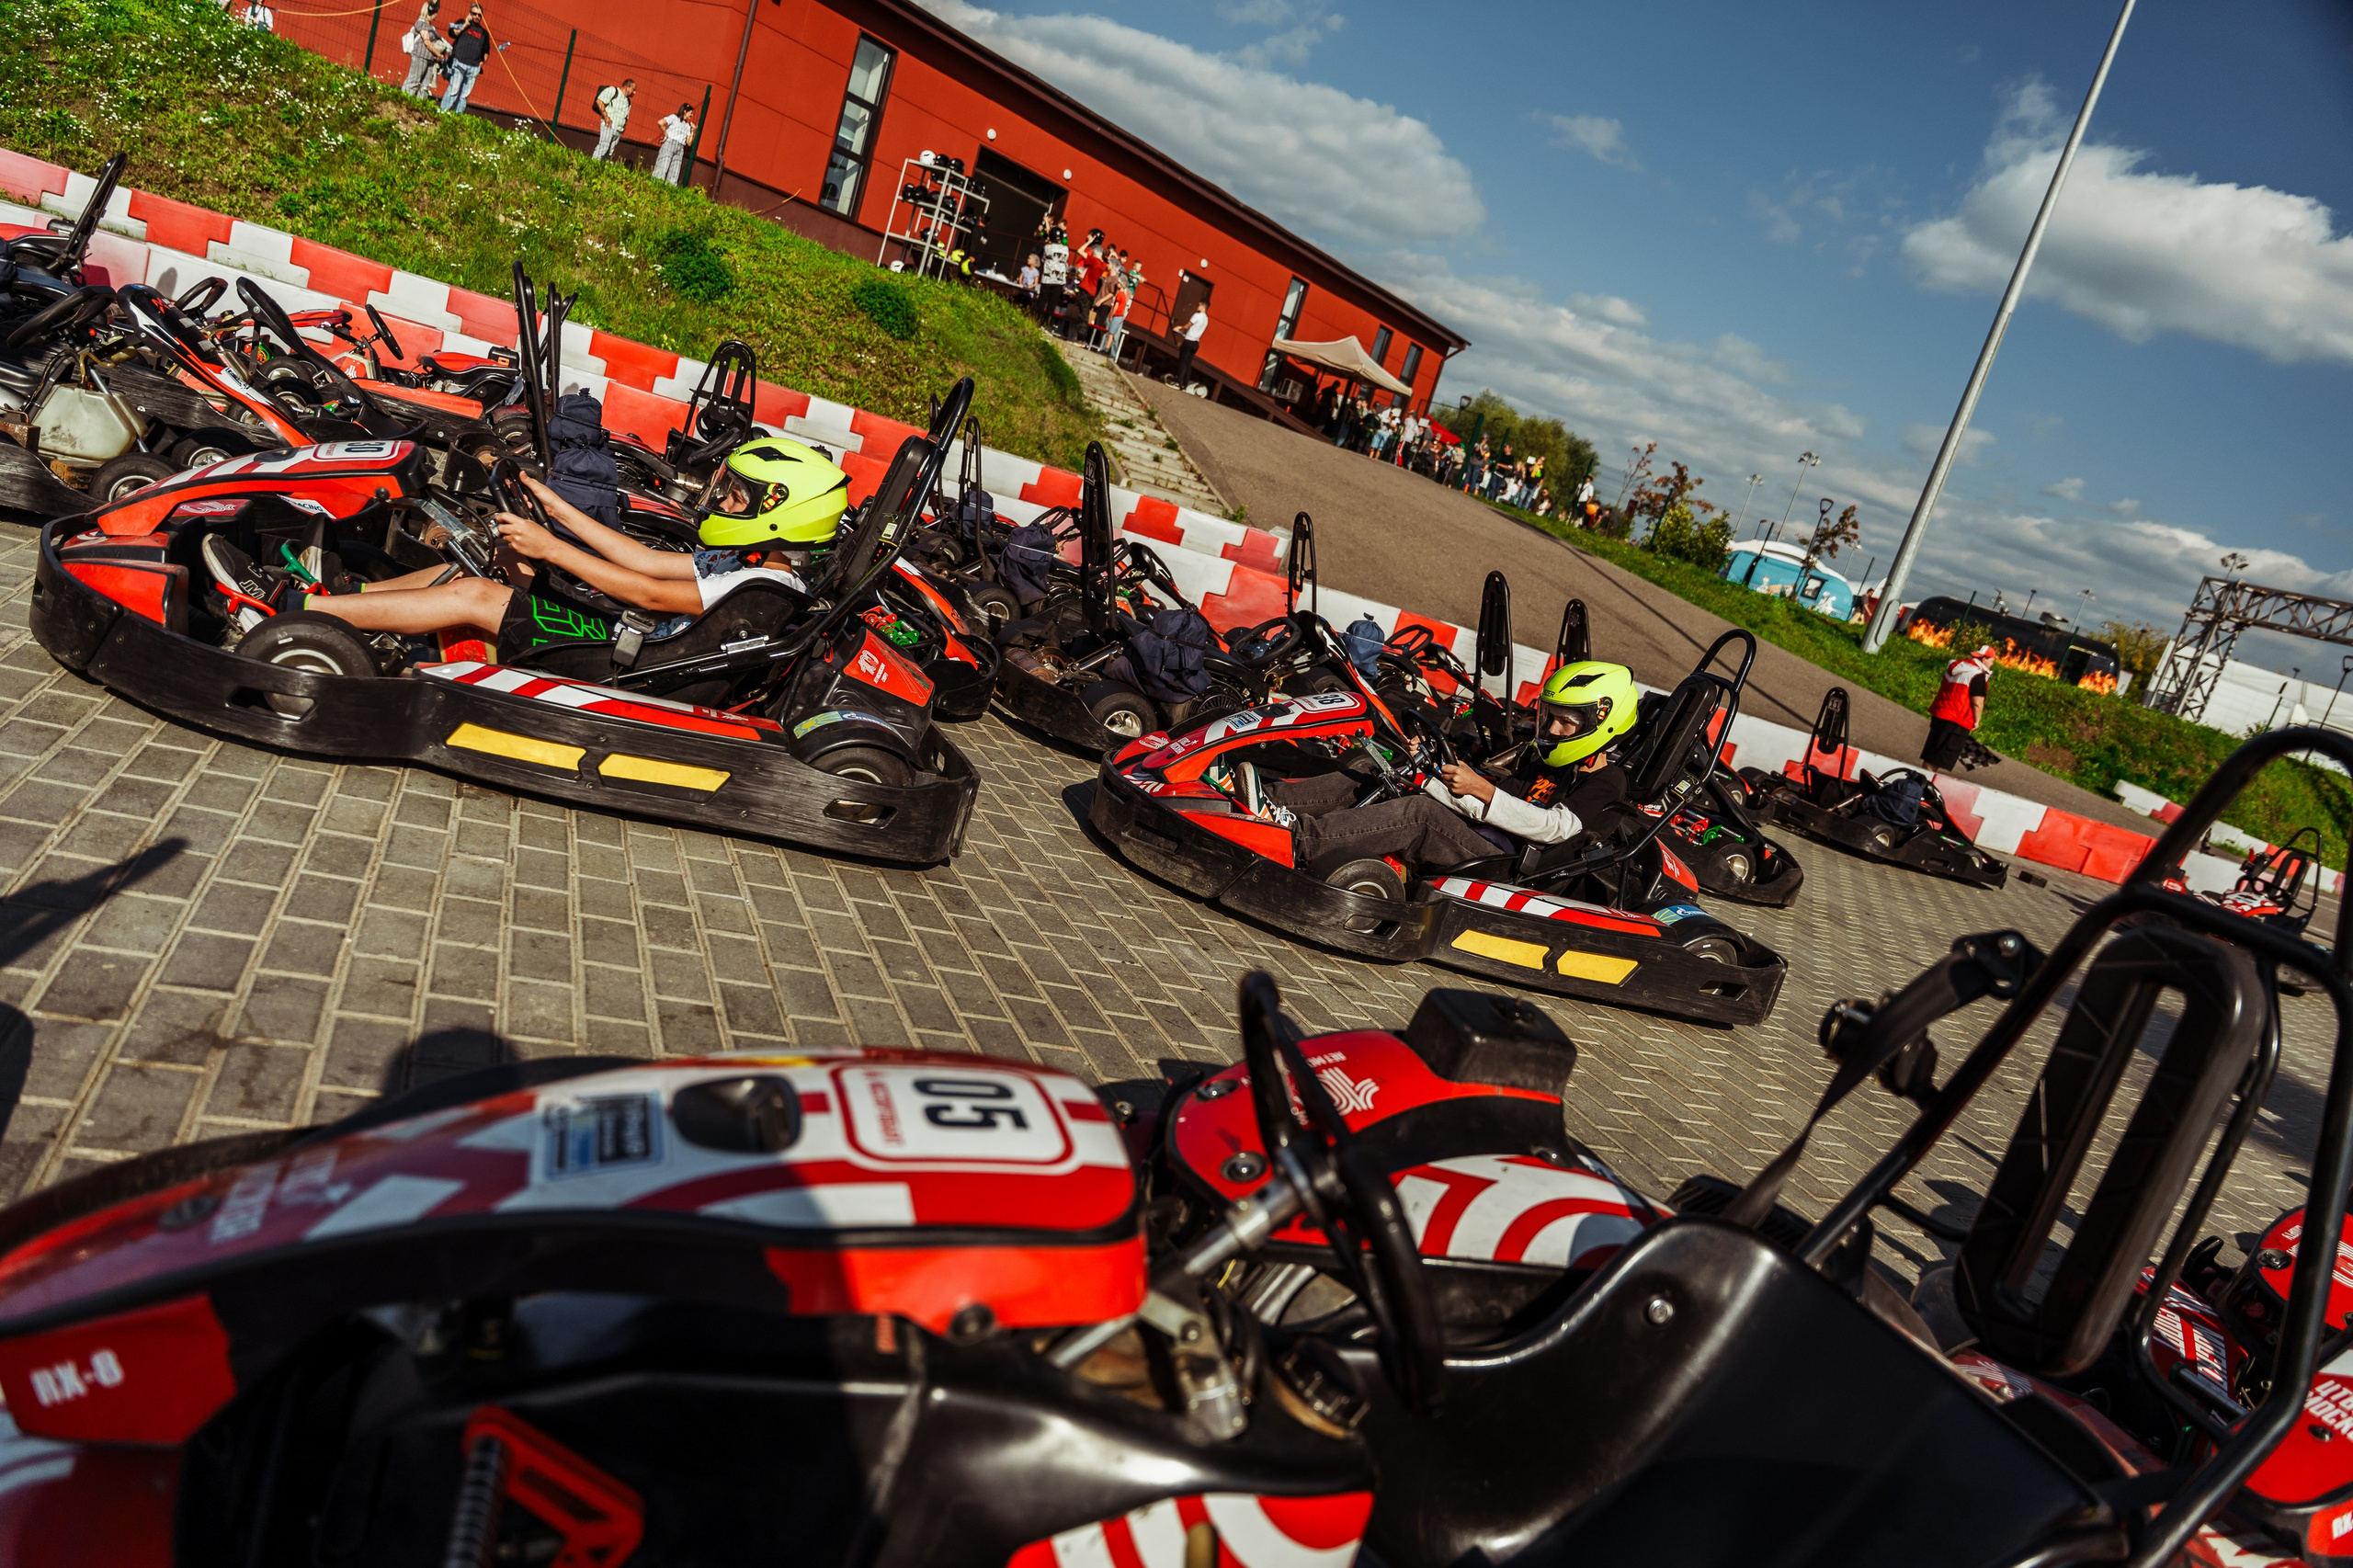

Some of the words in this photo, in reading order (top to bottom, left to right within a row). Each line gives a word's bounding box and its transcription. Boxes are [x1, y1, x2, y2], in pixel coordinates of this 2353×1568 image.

[345, 441, 386, 453] 30
[1312, 694, 1346, 705] 38
[913, 1078, 1029, 1130] 05
